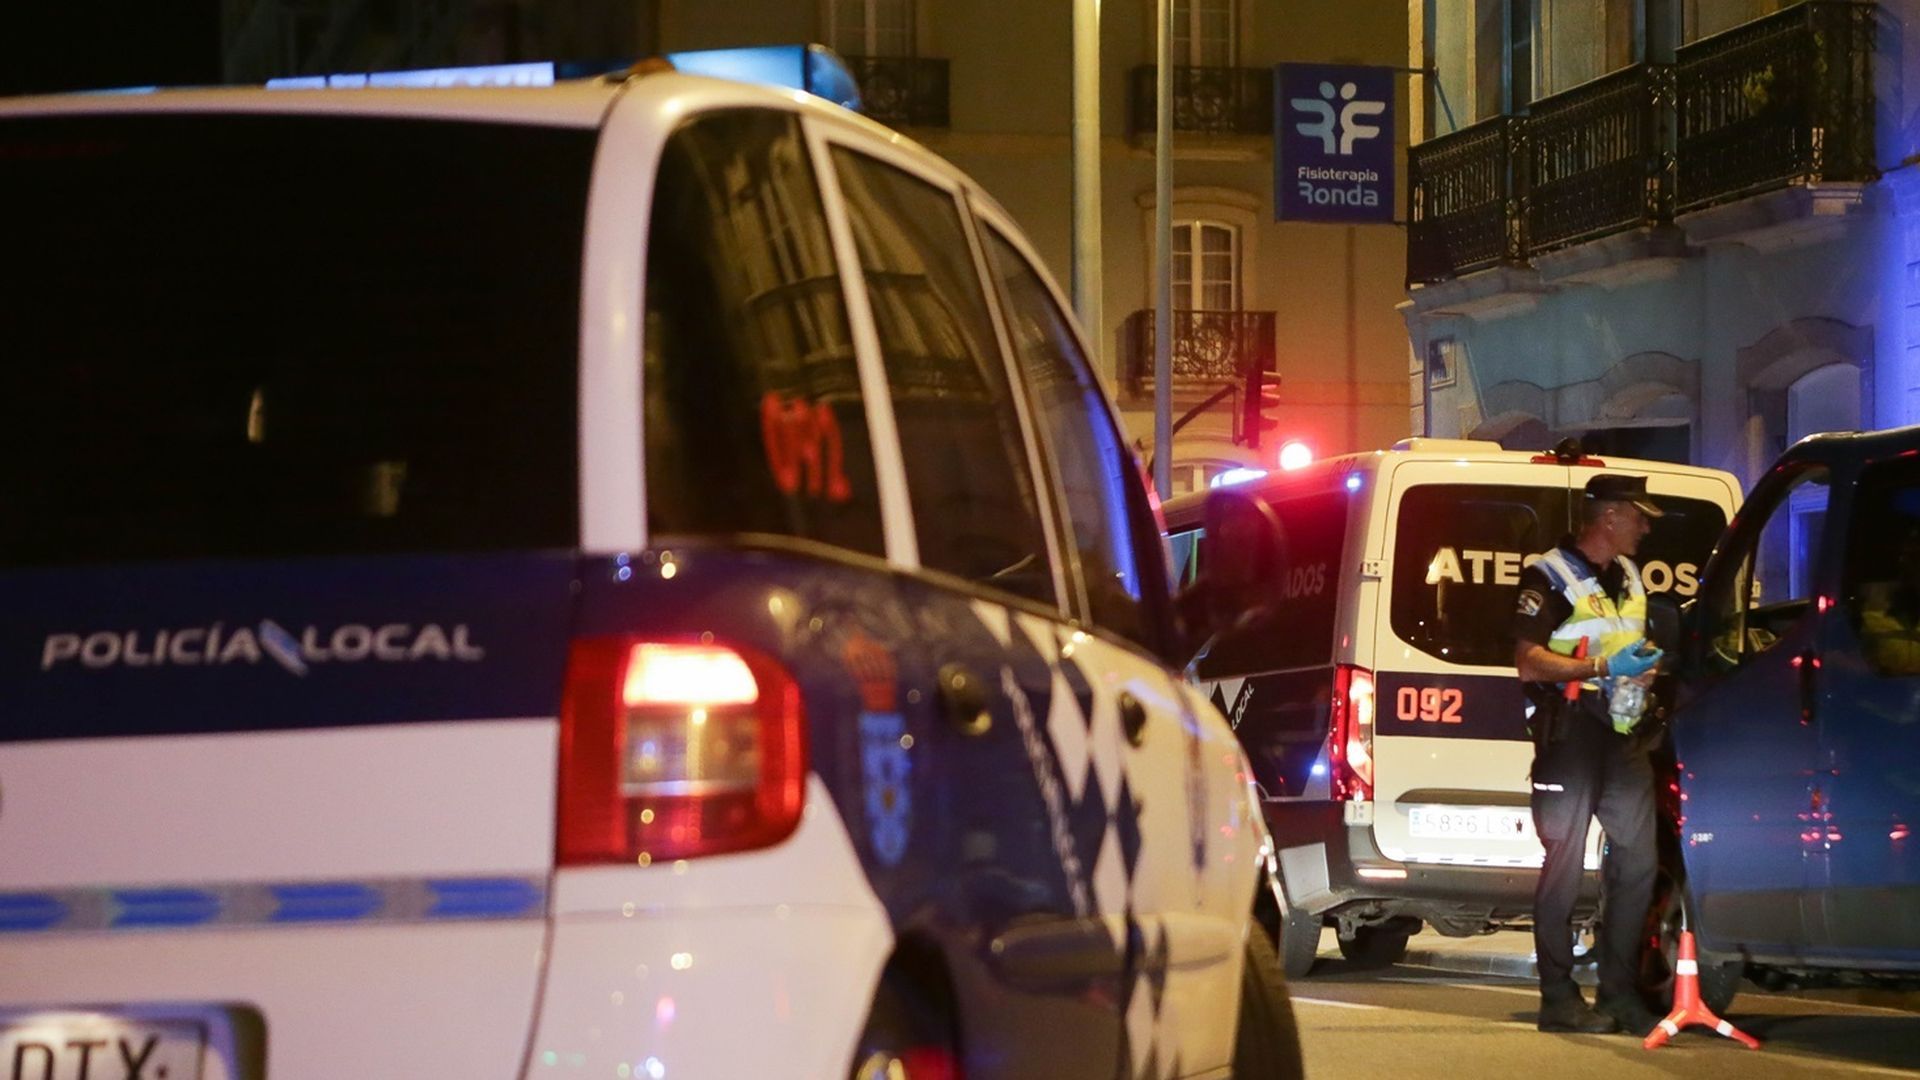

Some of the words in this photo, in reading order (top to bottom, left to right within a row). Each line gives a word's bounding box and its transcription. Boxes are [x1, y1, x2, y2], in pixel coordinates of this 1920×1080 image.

[1298, 166, 1379, 182] Fisioterapia
[1298, 182, 1379, 206] Ronda
[41, 622, 262, 670] POLICÍA
[302, 624, 486, 662] LOCAL
[1231, 683, 1255, 731] LOCAL
[1397, 687, 1463, 723] 092
